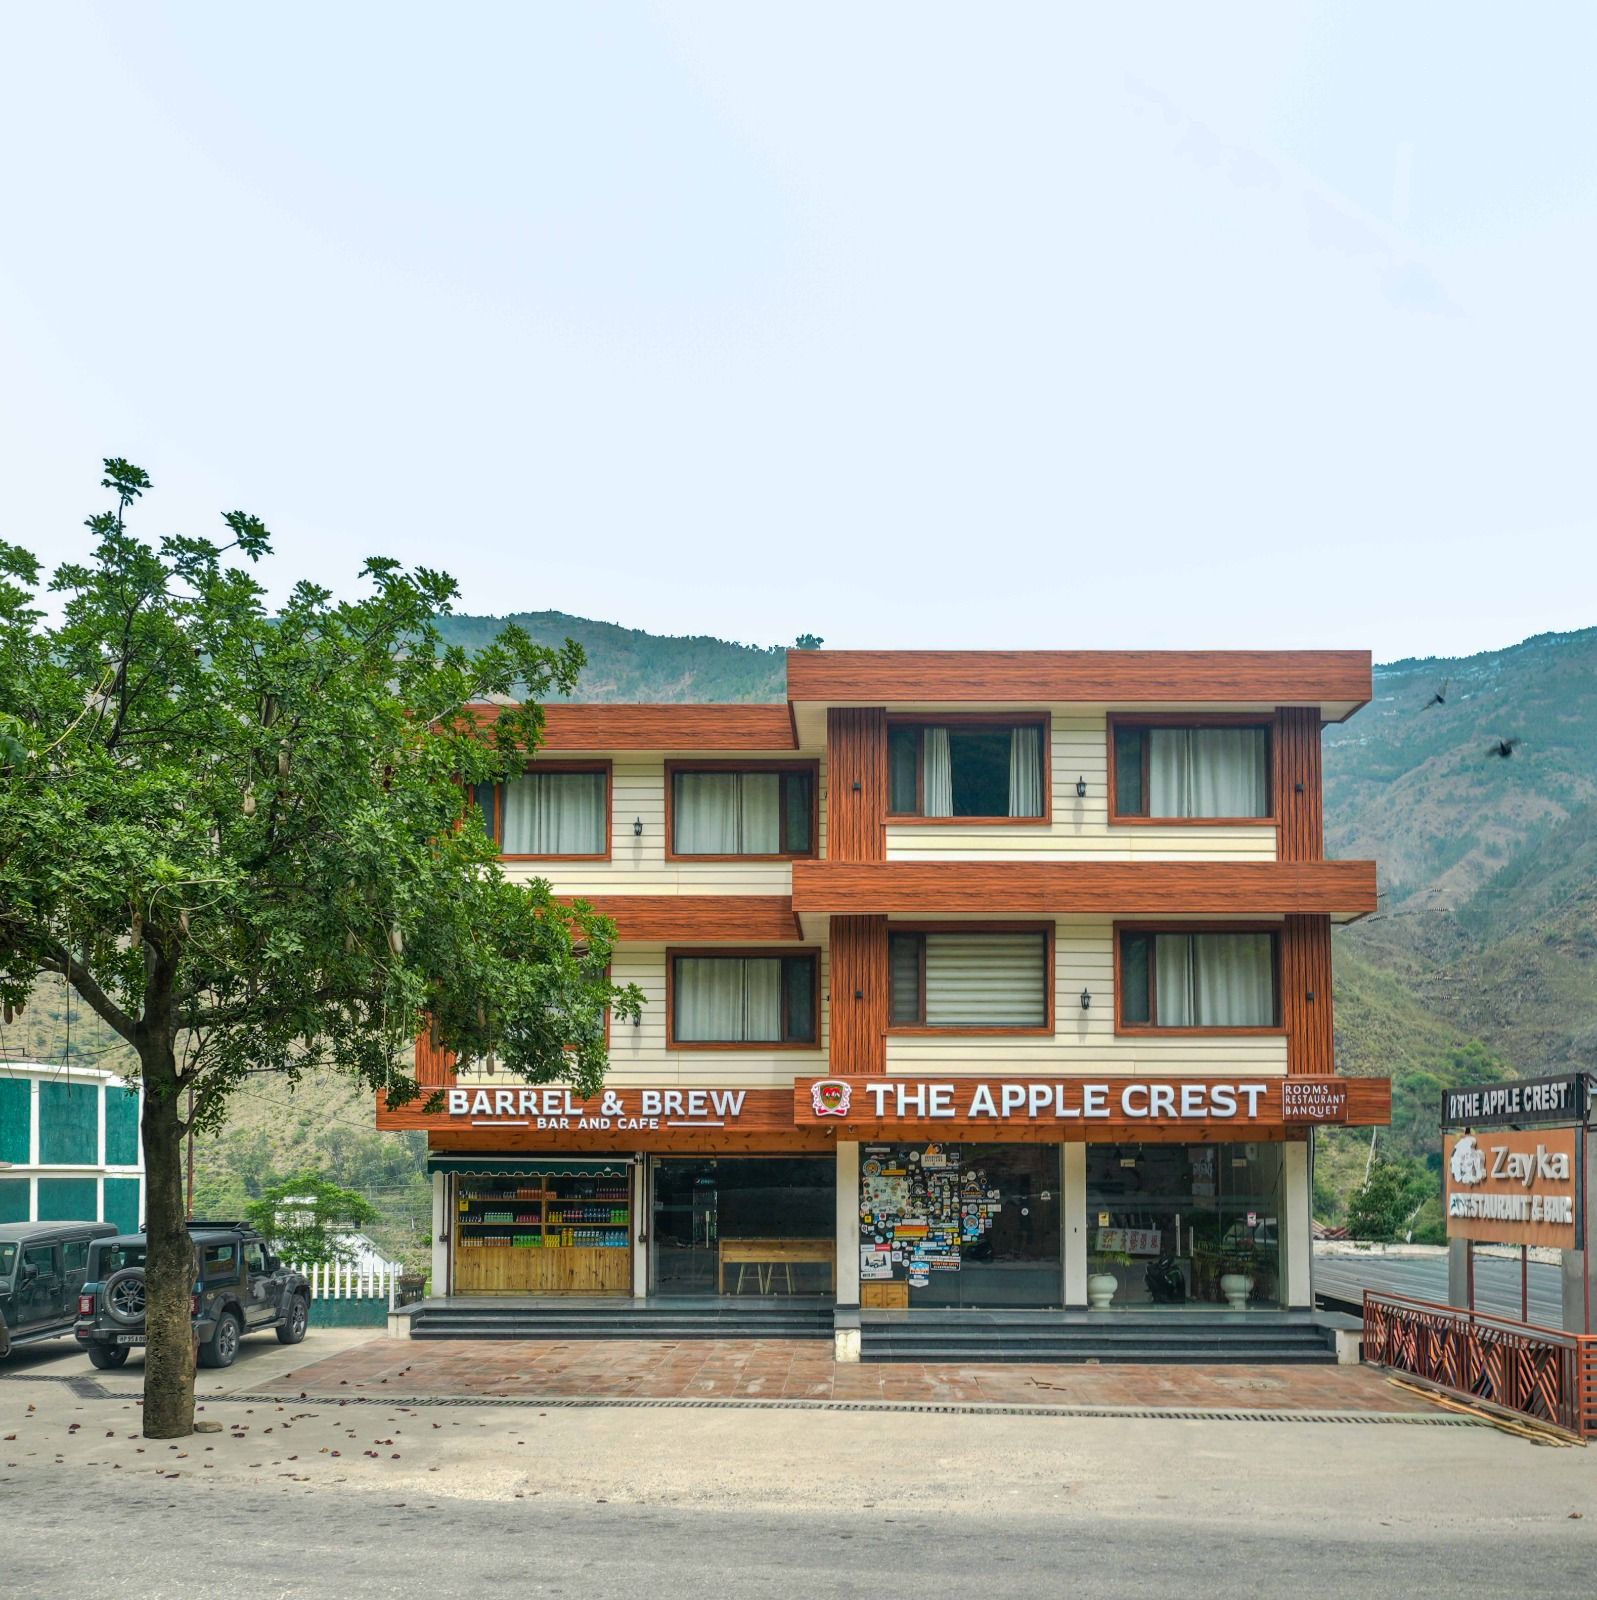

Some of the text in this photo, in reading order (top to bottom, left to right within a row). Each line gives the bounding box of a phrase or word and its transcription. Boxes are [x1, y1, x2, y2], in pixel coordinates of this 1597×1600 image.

[449, 1090, 746, 1116] BARREL & BREW
[866, 1084, 1267, 1118] THE APPLE CREST
[1285, 1085, 1329, 1095] ROOMS
[1285, 1094, 1346, 1105] RESTAURANT
[1457, 1093, 1480, 1118] THE
[1482, 1087, 1520, 1116] APPLE
[1523, 1082, 1568, 1112] CREST
[537, 1118, 659, 1130] BAR AND CAFE
[1285, 1105, 1339, 1117] BANQUET
[1490, 1144, 1570, 1187] Zayka
[1543, 1195, 1573, 1223] BAR
